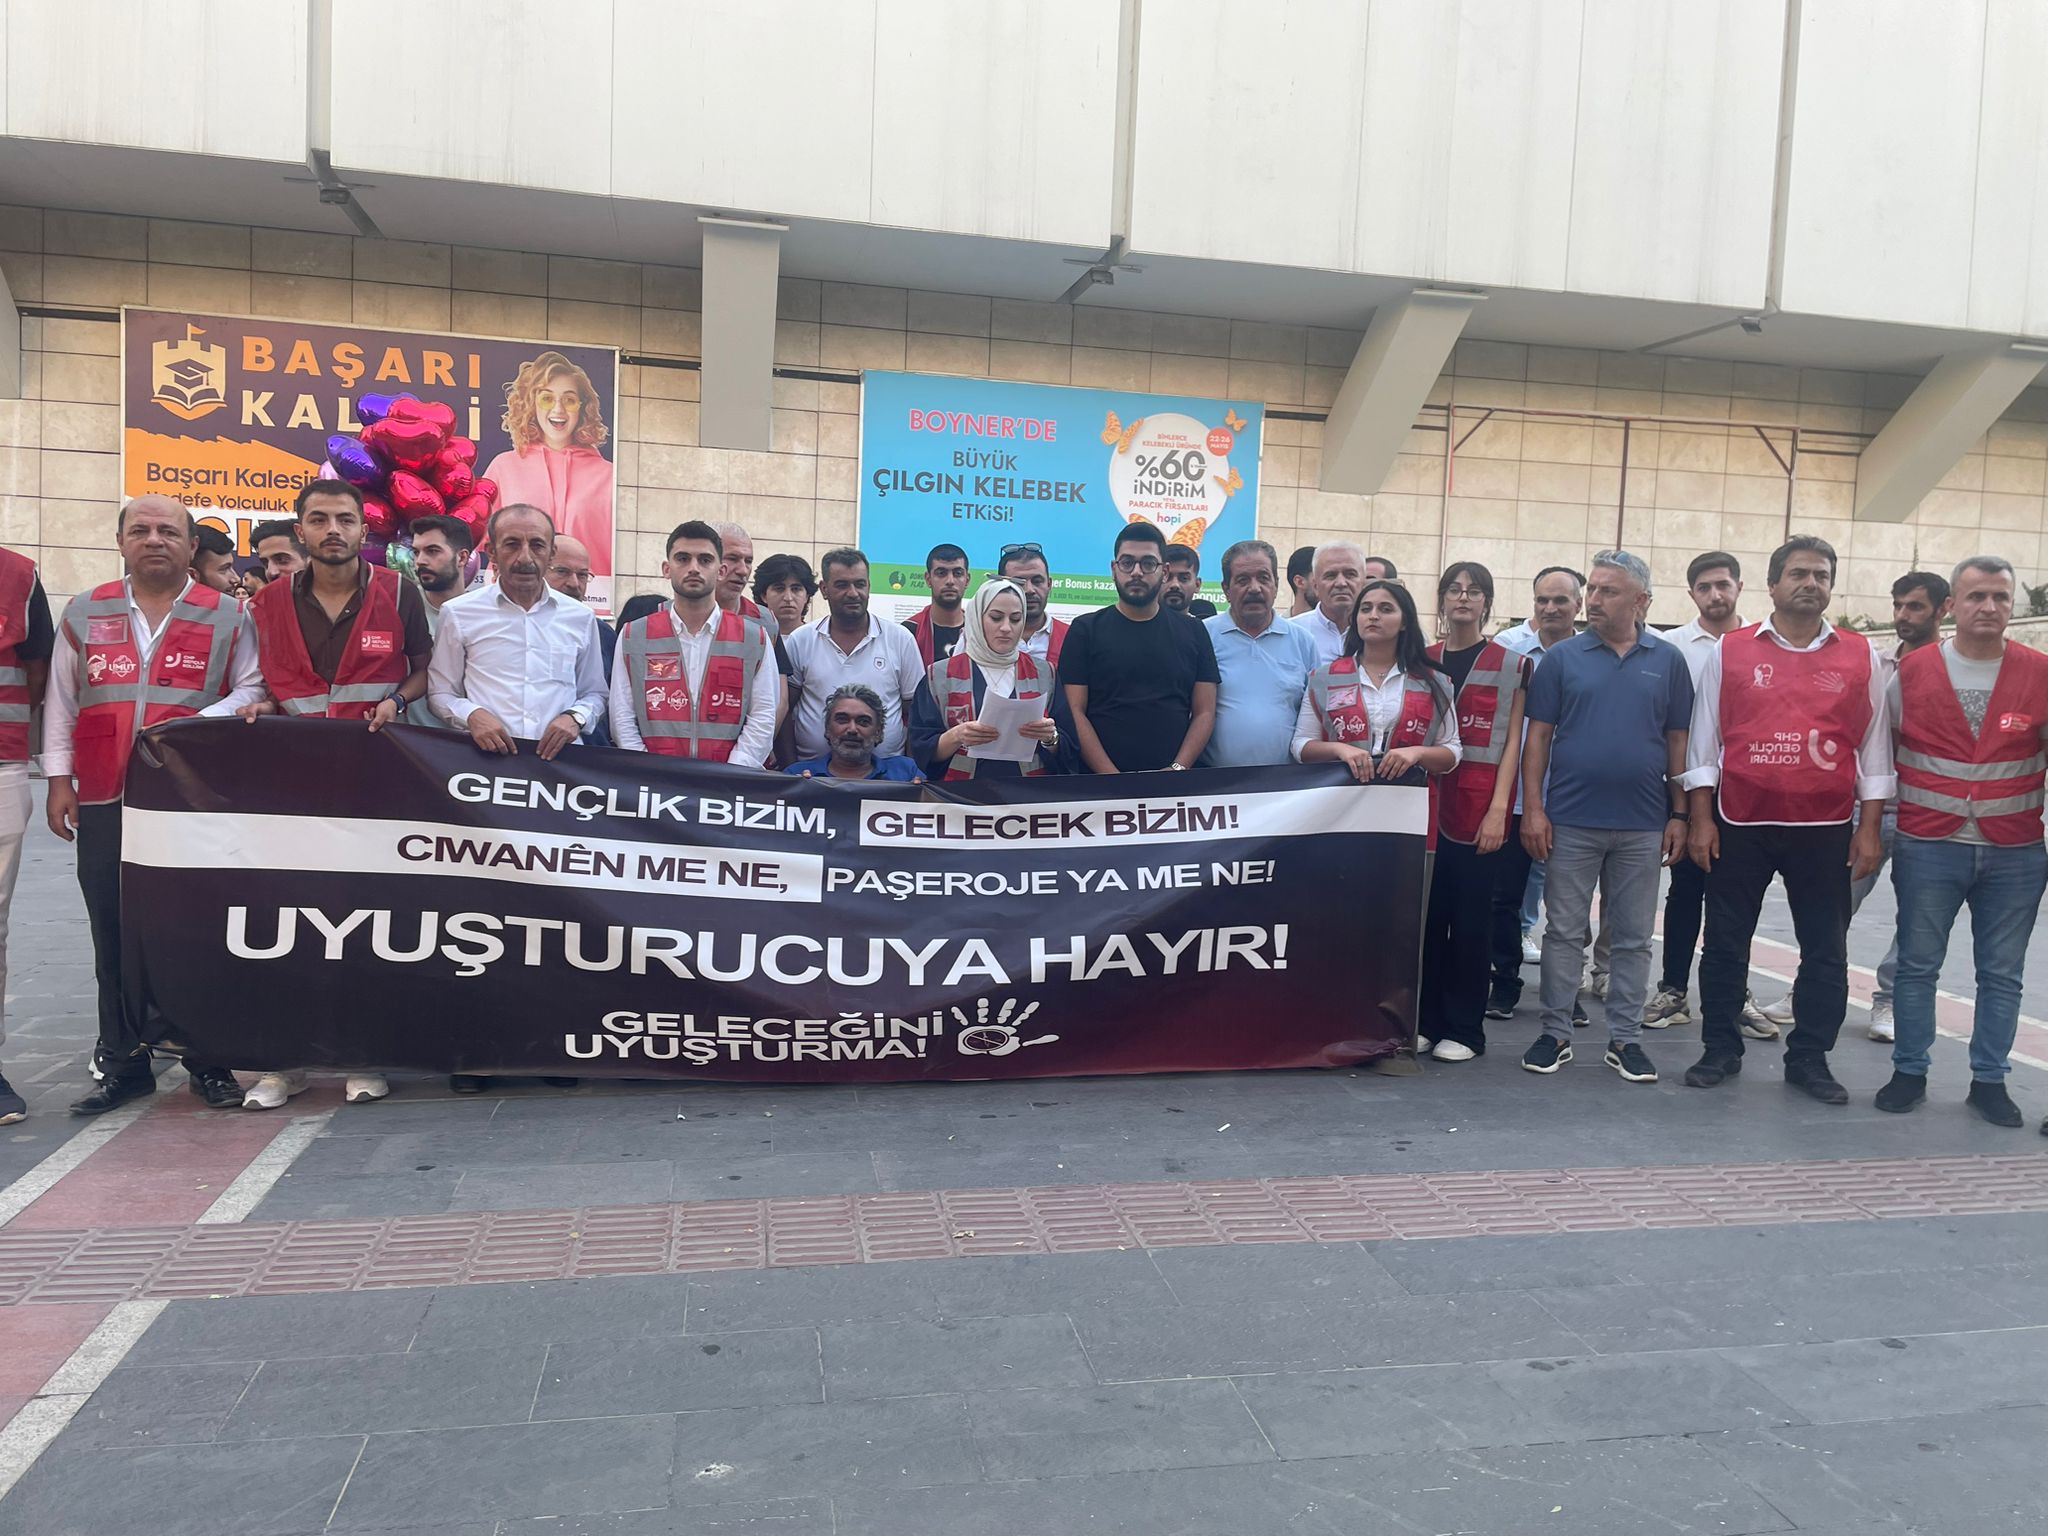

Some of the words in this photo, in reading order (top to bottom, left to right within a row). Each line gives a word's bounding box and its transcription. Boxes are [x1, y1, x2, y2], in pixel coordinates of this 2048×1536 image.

[241, 335, 481, 389] BAŞARI
[240, 389, 481, 441] KALİ
[909, 408, 1057, 441] BOYNER'DE
[146, 462, 228, 489] Başarı
[953, 447, 1018, 471] BÜYÜK
[1135, 449, 1206, 482] %60
[872, 468, 964, 498] ÇILGIN
[974, 475, 1088, 504] KELEBEK
[217, 494, 289, 512] Yolculuk
[1128, 500, 1162, 509] PARACIK
[1165, 502, 1208, 512] FIRSATLARI
[1156, 512, 1182, 525] hopi
[1065, 578, 1092, 589] Bonus
[109, 663, 137, 672] UMUT
[447, 772, 688, 822] GENÇLİK
[698, 795, 837, 840] BİZİM,
[866, 810, 1096, 840] GELECEK
[1105, 800, 1240, 837] BİZİM!
[397, 834, 626, 878] CIWANÊN
[637, 855, 706, 885] ME
[717, 860, 789, 894] NE,
[826, 866, 1059, 901] PAŞEROJE
[1066, 868, 1129, 894] YA
[1137, 863, 1201, 890] ME
[1211, 859, 1277, 886] NE!
[225, 905, 1012, 987] UYUŞTURUCUYA
[1029, 923, 1289, 984] HAYIR!
[564, 1033, 928, 1066] UYUŞTURMA!
